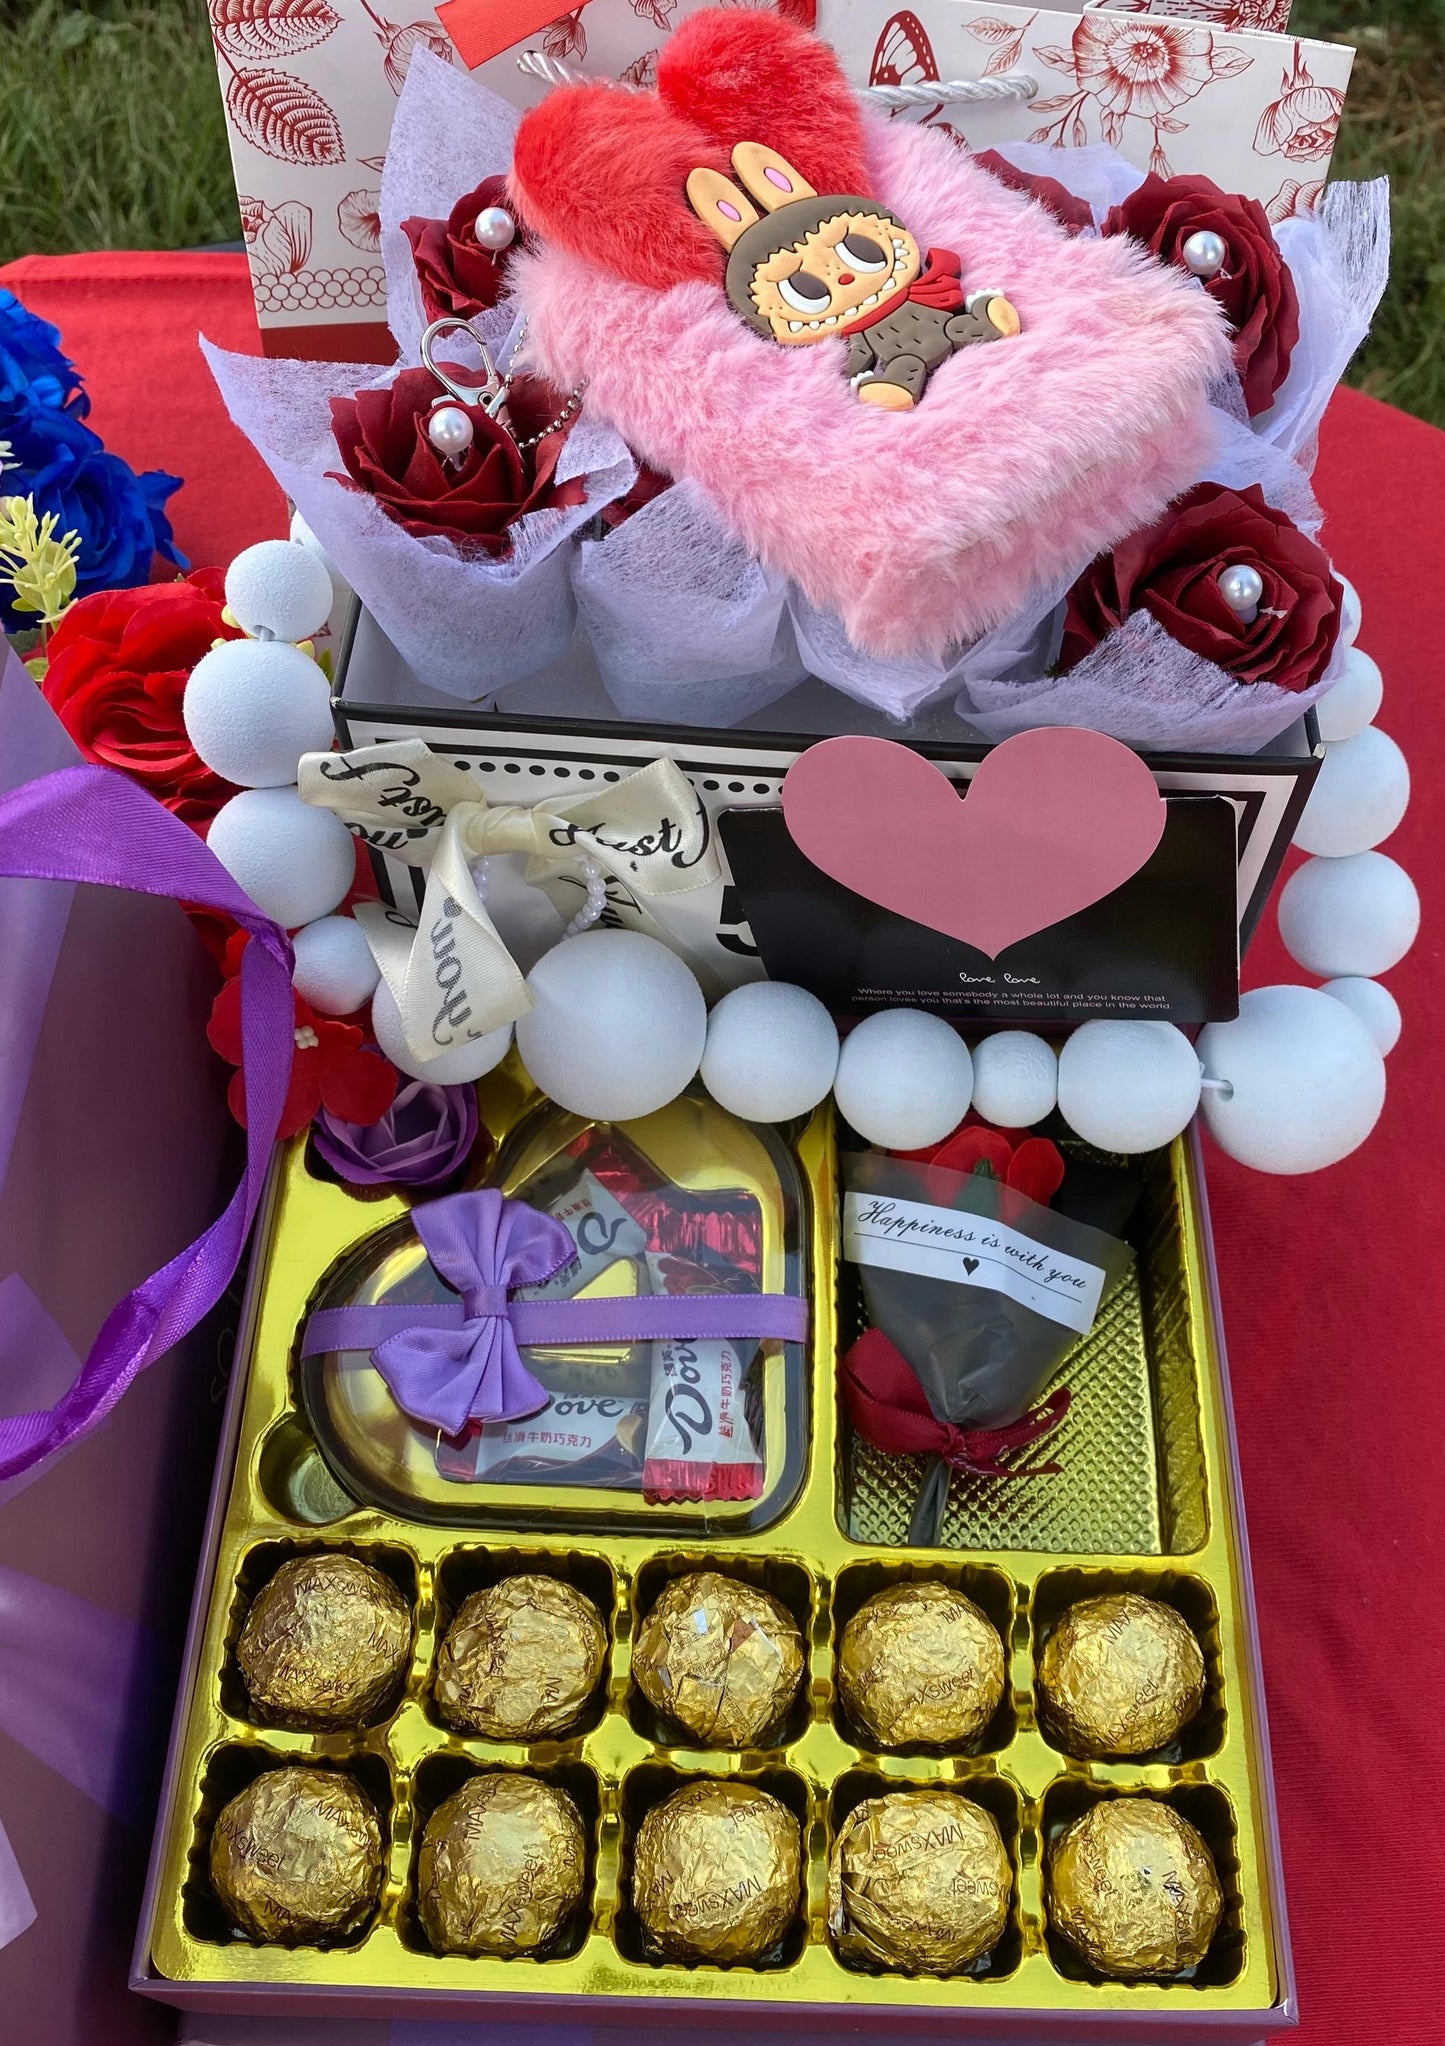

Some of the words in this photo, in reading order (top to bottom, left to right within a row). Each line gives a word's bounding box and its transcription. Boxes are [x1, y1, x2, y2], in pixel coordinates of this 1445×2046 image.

[959, 972, 996, 983] love
[1003, 972, 1041, 984] love
[889, 995, 918, 1003] loves
[942, 996, 971, 1004] that's
[973, 997, 990, 1005] the
[1022, 999, 1069, 1007] beautiful
[1118, 1001, 1136, 1009] the
[943, 990, 998, 999] somebody
[1110, 993, 1141, 1001] know
[1143, 994, 1166, 1002] that
[857, 1199, 977, 1242] Happiness
[981, 1232, 1002, 1249] is
[1004, 1243, 1045, 1272] with
[1048, 1265, 1087, 1289] you
[665, 1337, 712, 1454] Dov
[545, 1394, 624, 1418] ove
